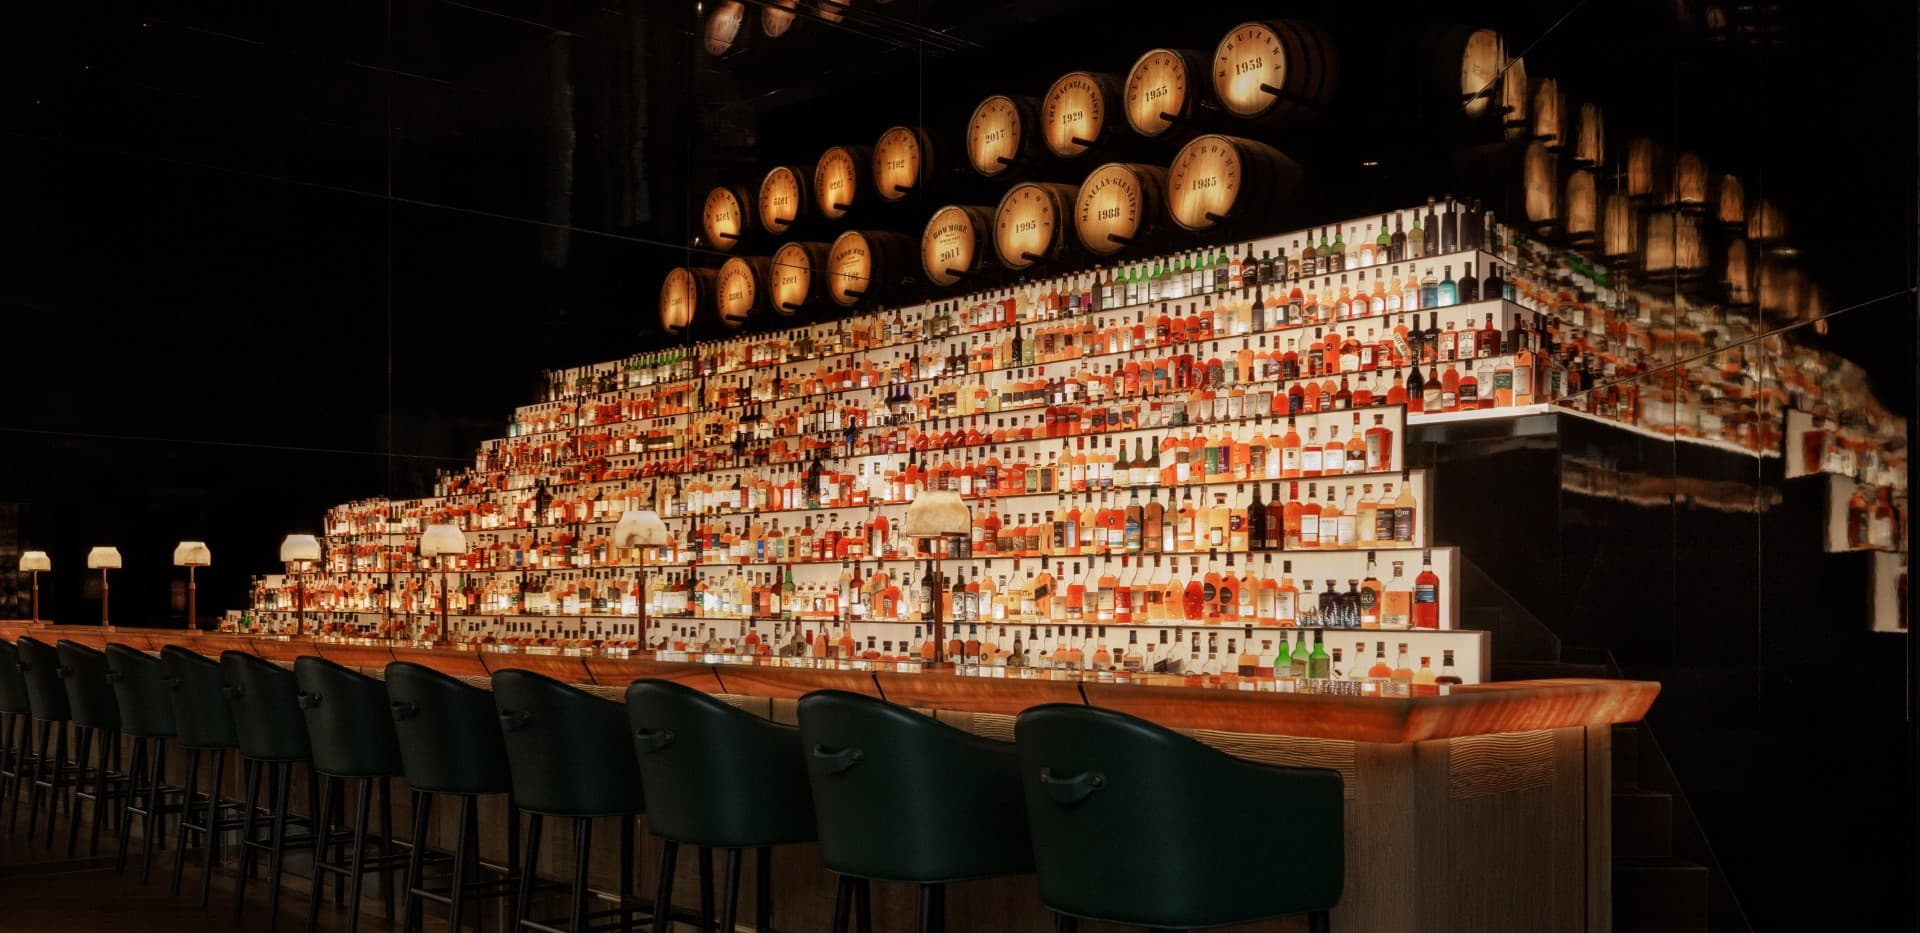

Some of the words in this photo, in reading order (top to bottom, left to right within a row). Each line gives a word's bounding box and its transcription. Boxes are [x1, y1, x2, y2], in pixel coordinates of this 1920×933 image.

[1218, 30, 1283, 78] KARUIZAWA
[1235, 57, 1263, 76] 1958
[1145, 85, 1168, 102] 1955
[1063, 111, 1083, 125] 1929
[985, 129, 1005, 144] 2017
[1192, 177, 1217, 191] 1985
[1098, 207, 1120, 221] 1988
[932, 223, 967, 240] BOWMORE
[1015, 220, 1036, 234] 1995
[940, 247, 959, 262] 2011
